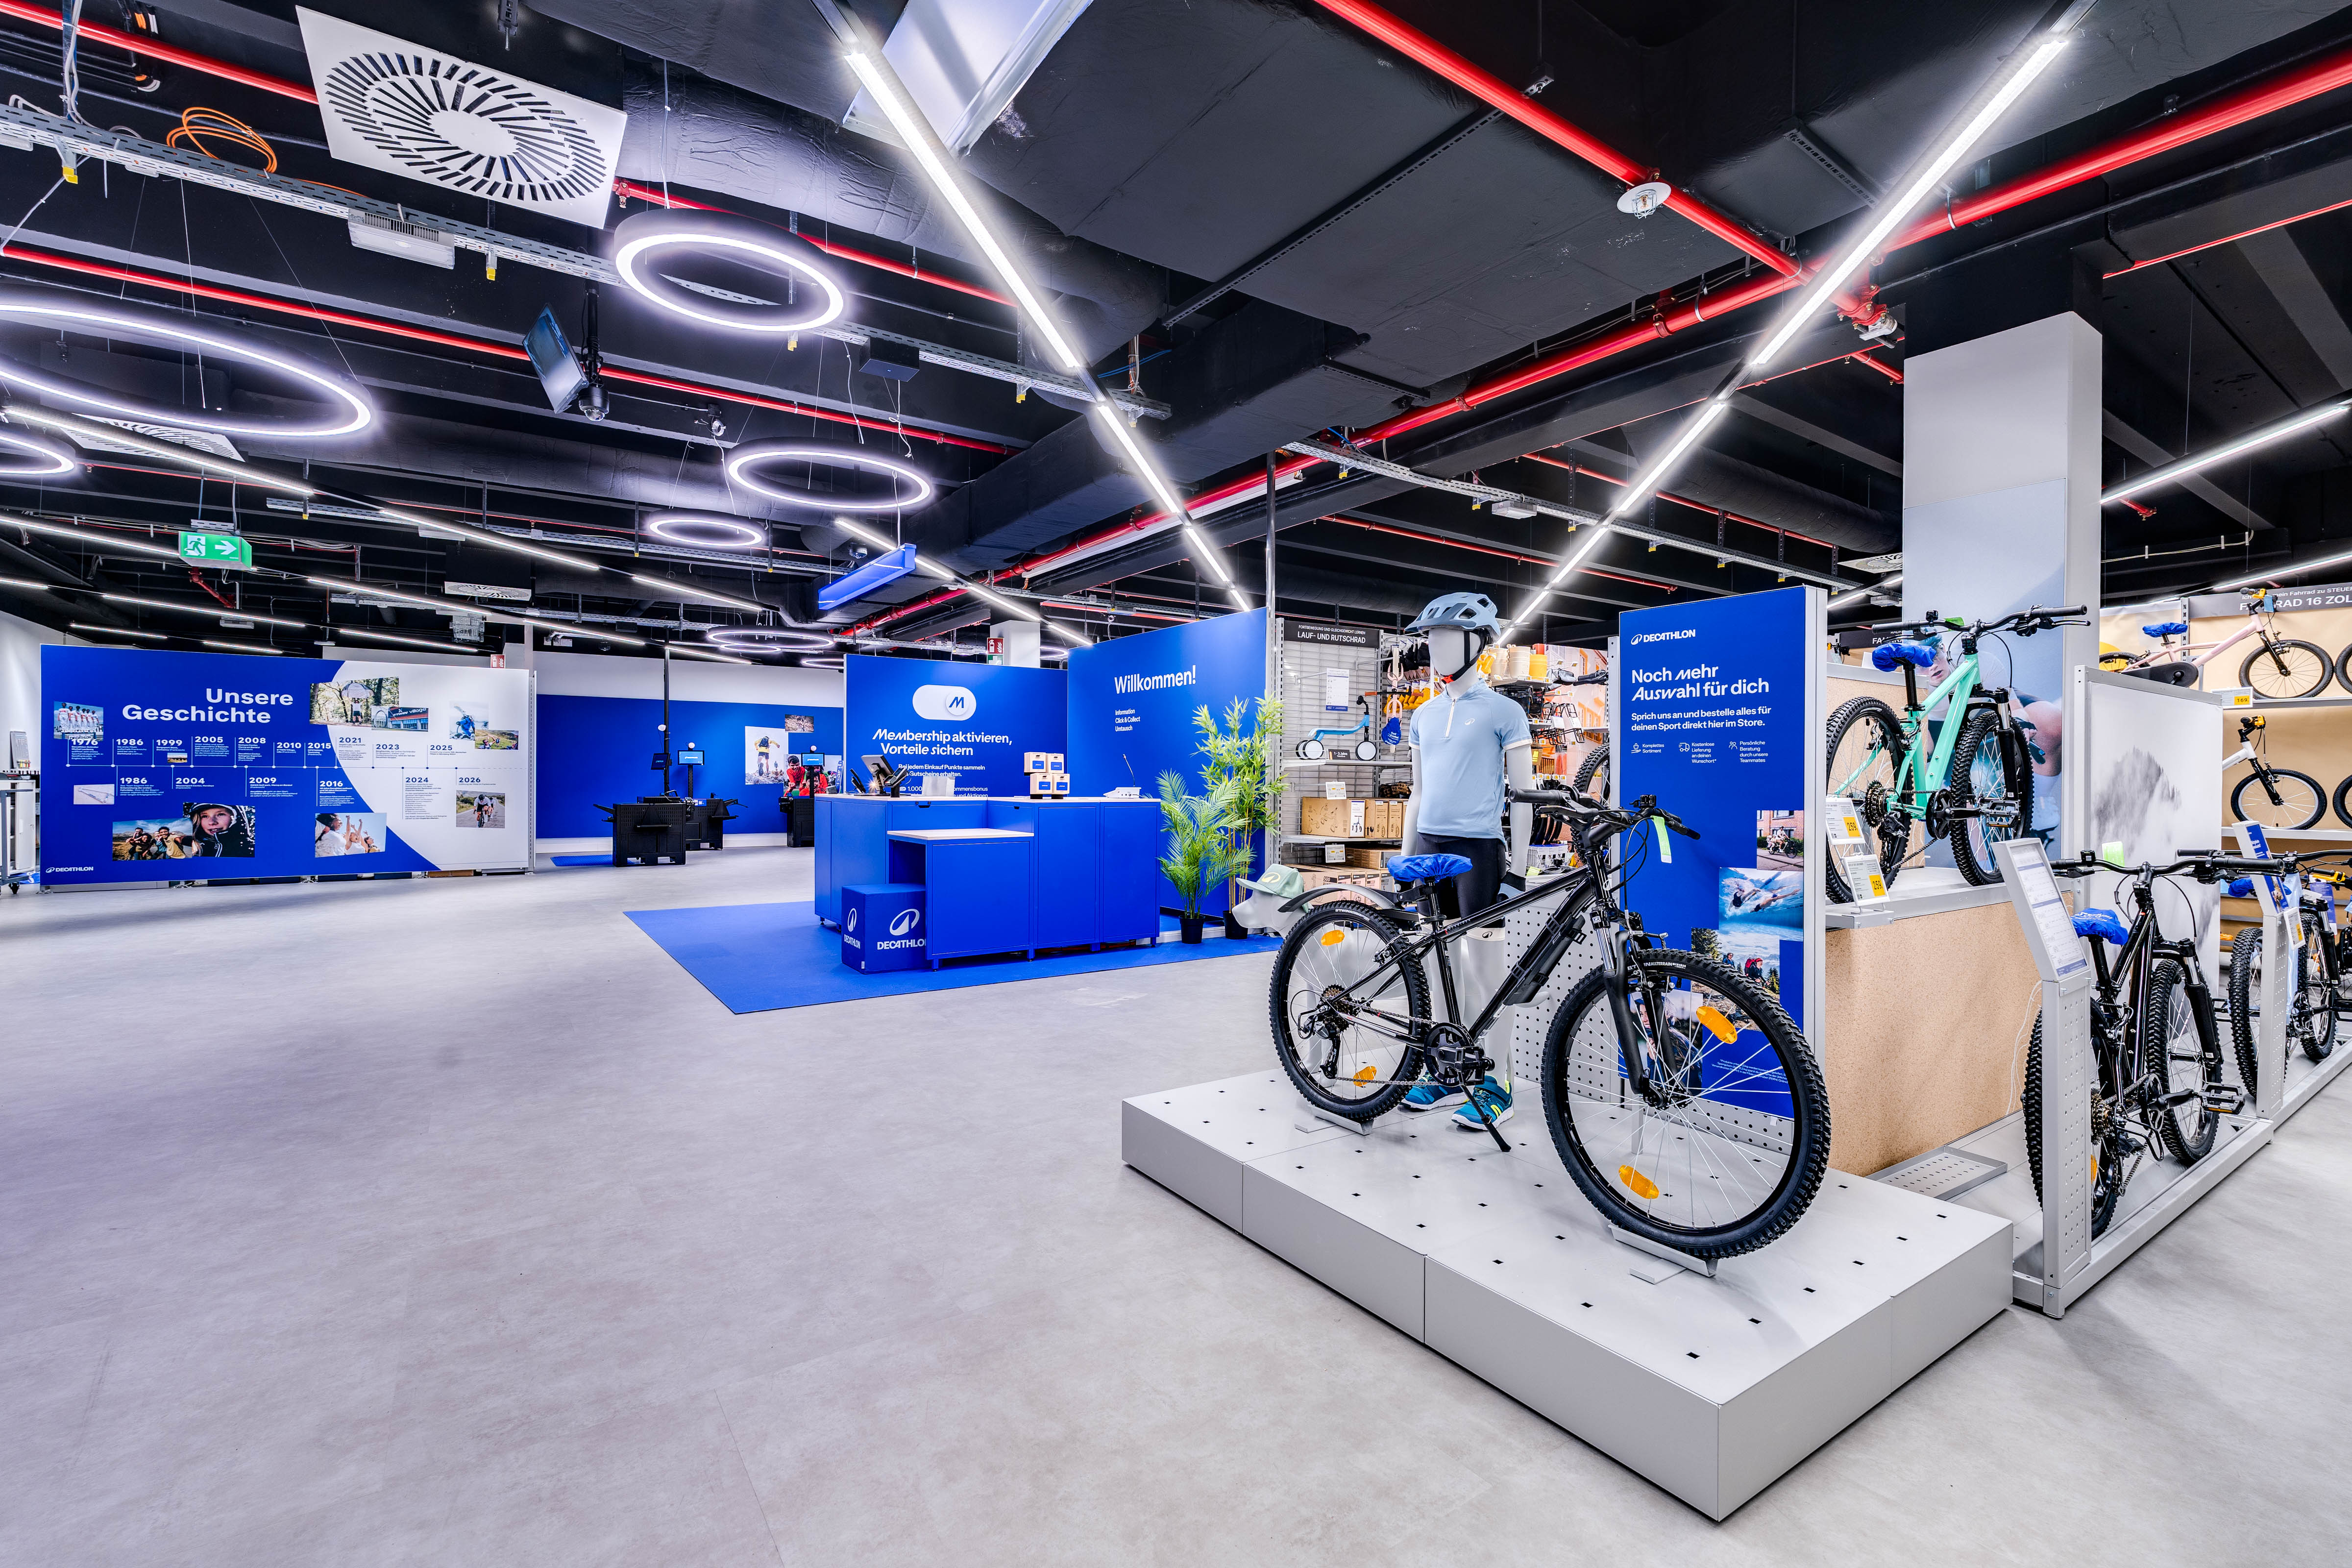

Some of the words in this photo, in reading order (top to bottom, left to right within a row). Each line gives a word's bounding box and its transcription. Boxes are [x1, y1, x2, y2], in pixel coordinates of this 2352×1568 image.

[2306, 597, 2322, 606] 16
[1331, 634, 1366, 643] RUTSCHRAD
[1643, 629, 1696, 642] DECATHLON
[1114, 665, 1196, 694] Willkommen!
[1632, 667, 1672, 684] Noch
[206, 688, 294, 706] Unsere
[1631, 683, 1700, 701] Auswahl
[1703, 681, 1728, 696] für
[1730, 678, 1769, 695] dich
[122, 704, 271, 723] Geschichte
[1632, 712, 1656, 722] Sprich
[1684, 709, 1700, 718] und
[1700, 708, 1735, 717] bestelle
[1736, 707, 1757, 716] alles
[1757, 706, 1771, 714] für
[1632, 723, 1657, 732] deinen
[1658, 722, 1681, 732] Sport
[1682, 720, 1707, 729] direkt
[1708, 720, 1725, 728] hier
[1737, 718, 1765, 727] Store.
[872, 729, 951, 744] Membership
[952, 731, 1012, 745] aktivieren,
[881, 743, 930, 755] Vorteile
[931, 744, 973, 756] sichern
[844, 933, 860, 949] DECATHLON
